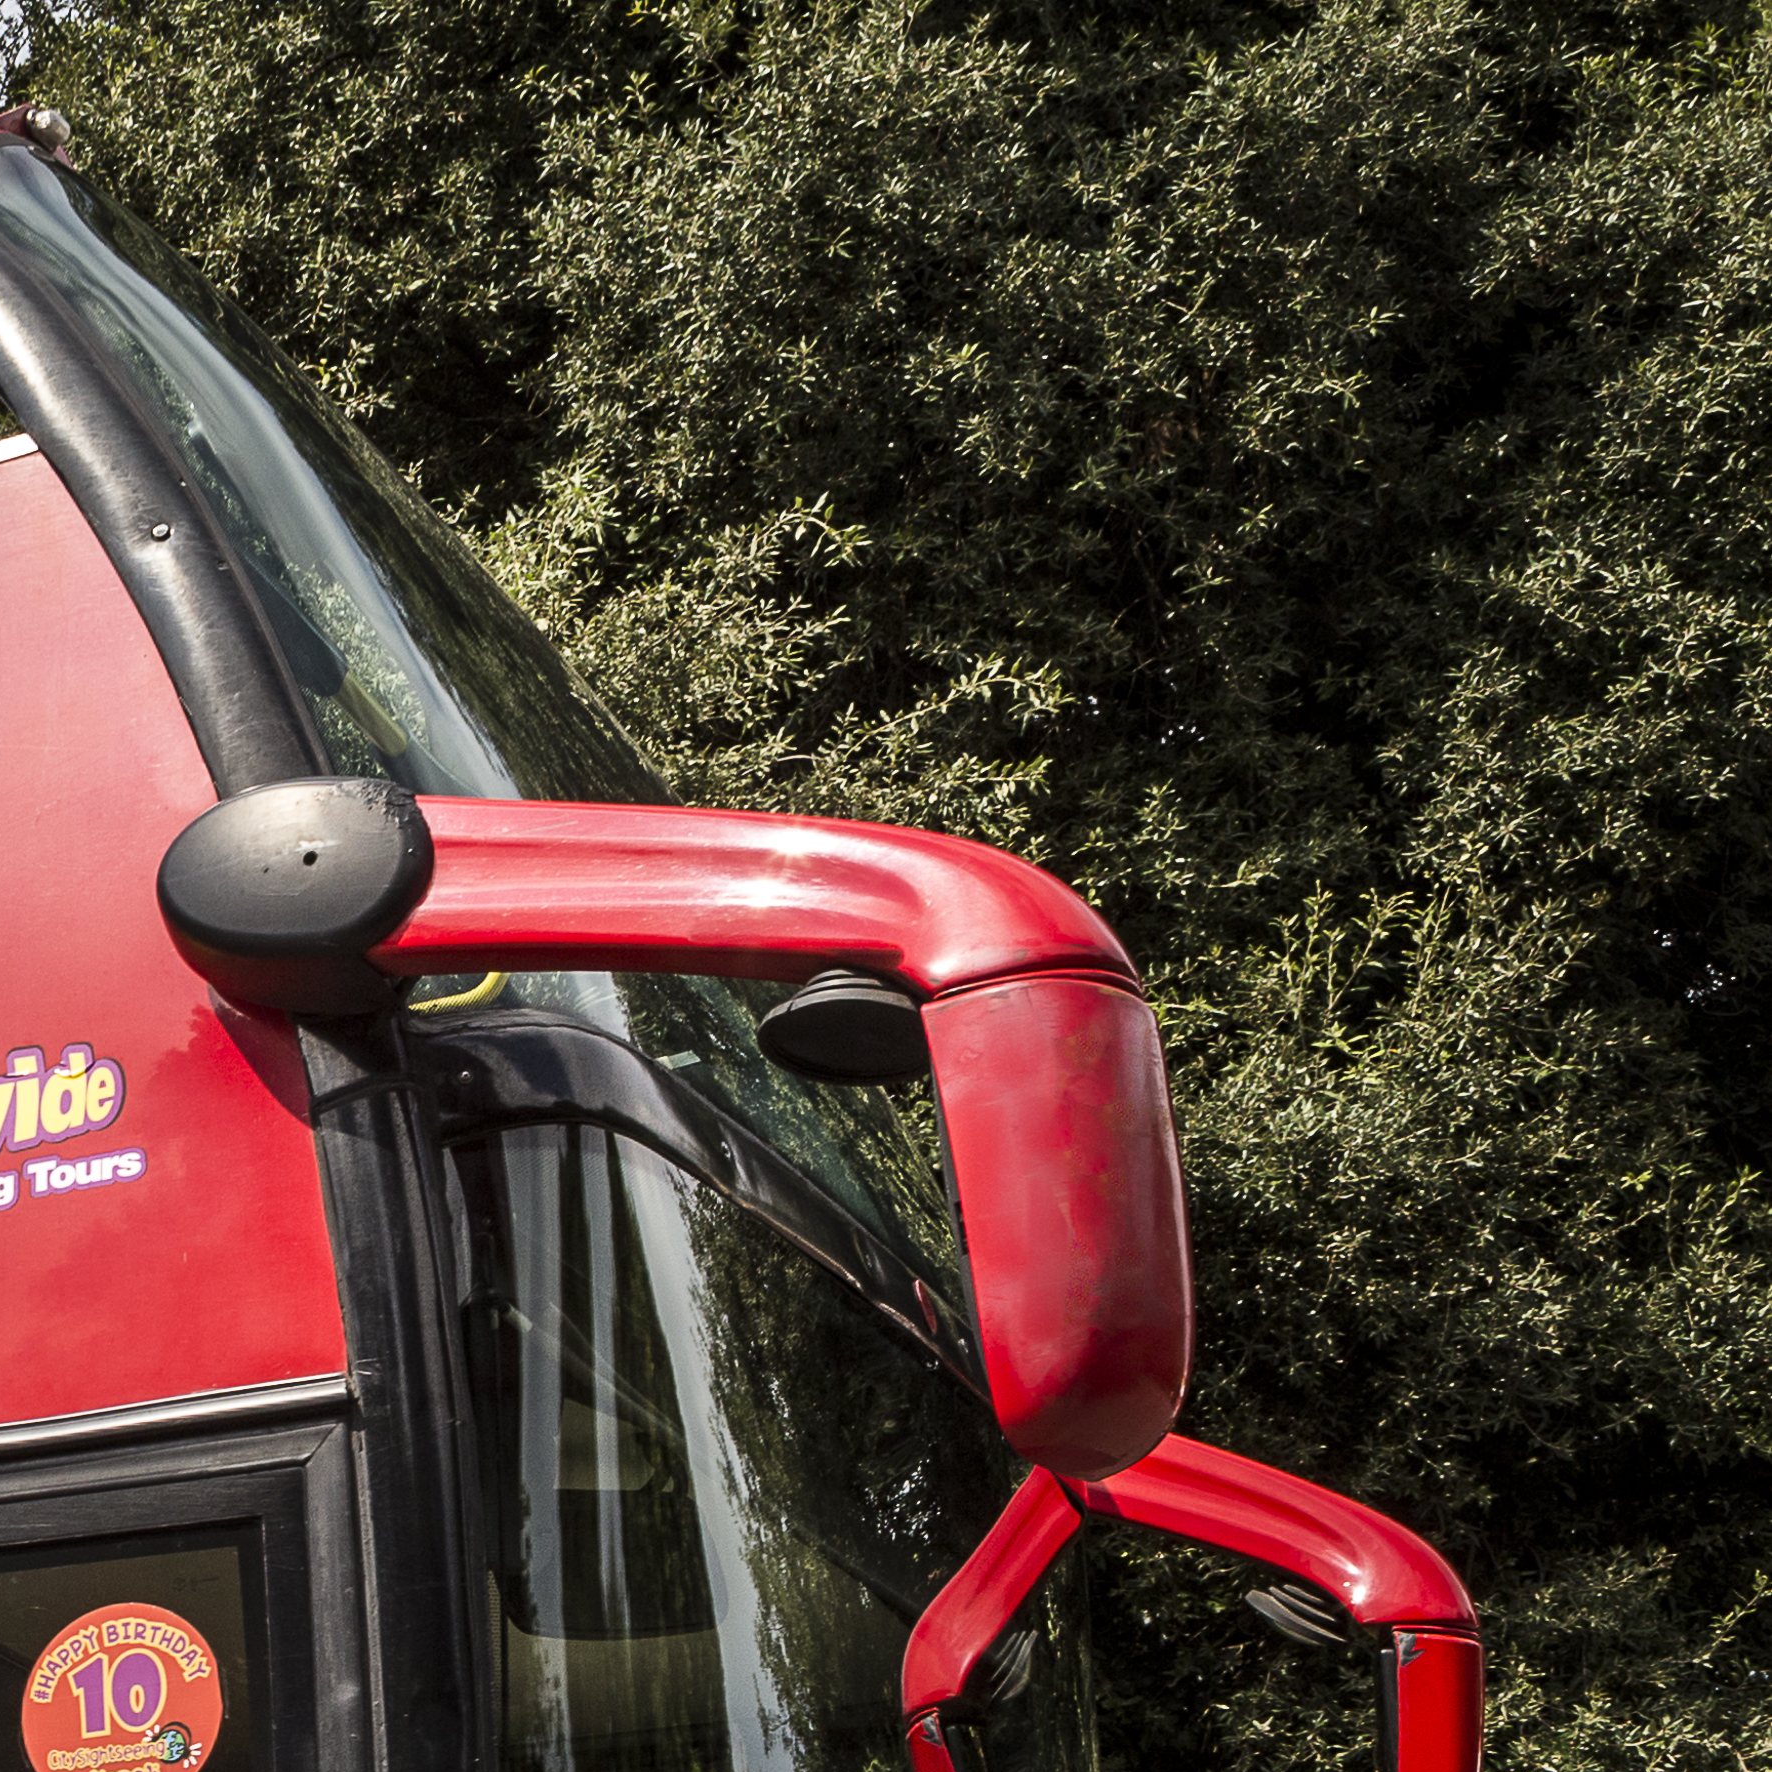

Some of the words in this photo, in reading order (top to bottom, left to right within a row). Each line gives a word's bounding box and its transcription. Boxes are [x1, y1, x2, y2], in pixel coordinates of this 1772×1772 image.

[26, 1150, 143, 1194] Tours
[101, 1617, 212, 1683] BIRTHDAY
[67, 1647, 168, 1739] 10
[47, 1740, 168, 1771] CitySightseeing
